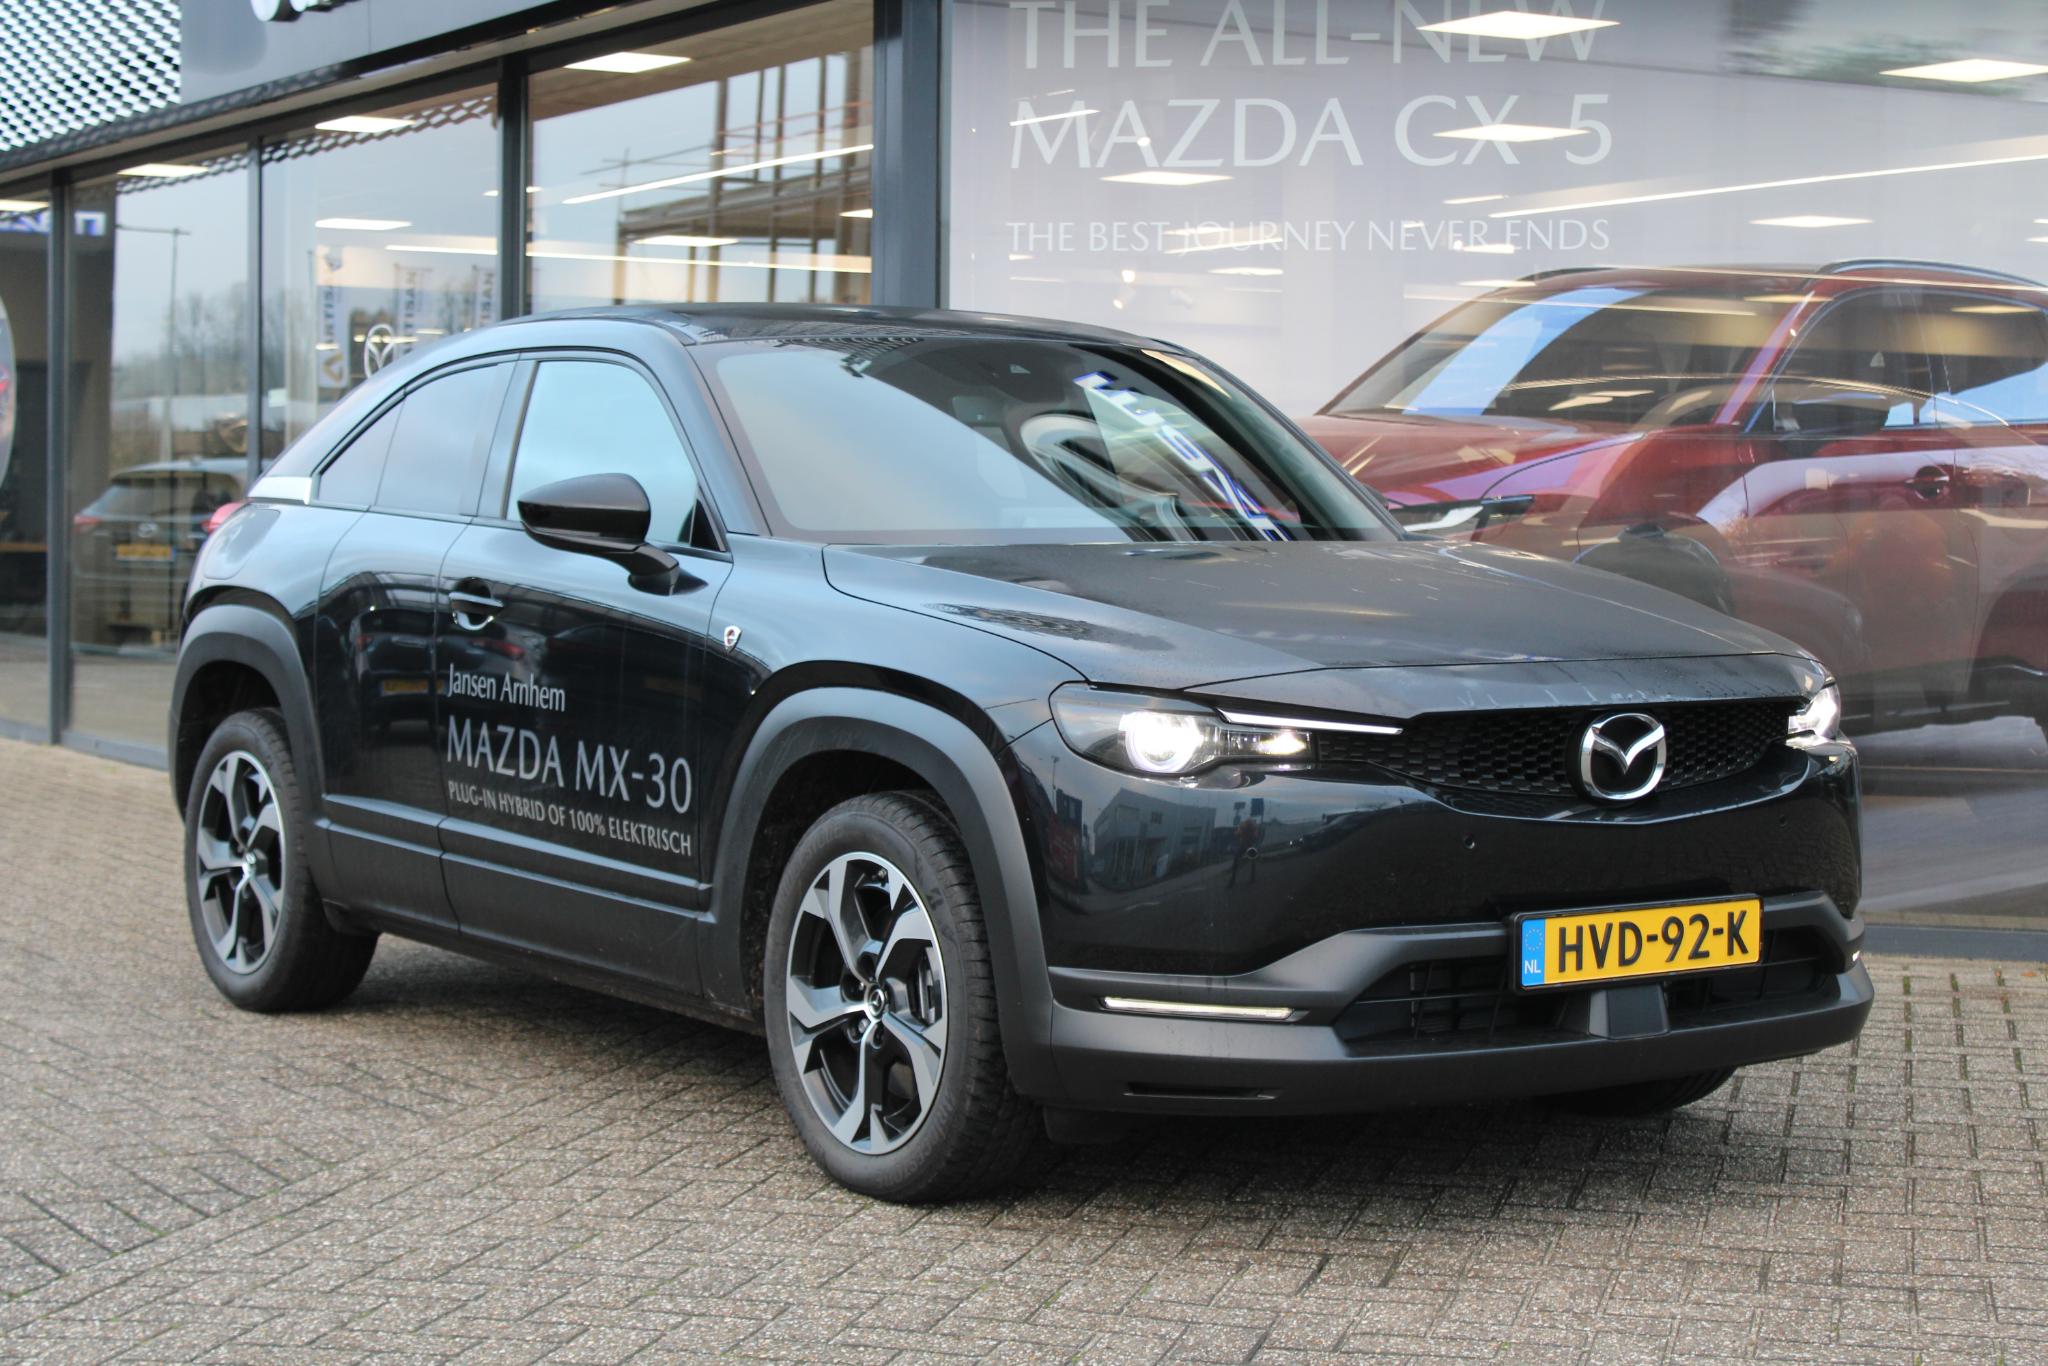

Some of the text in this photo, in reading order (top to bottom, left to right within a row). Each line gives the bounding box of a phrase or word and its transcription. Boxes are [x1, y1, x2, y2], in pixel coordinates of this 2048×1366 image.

[1010, 0, 1173, 68] THE
[1010, 98, 1364, 168] MAZDA
[1005, 218, 1610, 256] THE BEST JOURNEY NEVER ENDS
[447, 662, 566, 713] Jansen Arnhem
[447, 714, 693, 815] MAZDA MX-30
[447, 780, 692, 857] PLUG-IN HYBRID OF 100% ELEKTRISCH
[1523, 959, 1542, 975] NL
[1558, 910, 1750, 974] HVD-92-K
